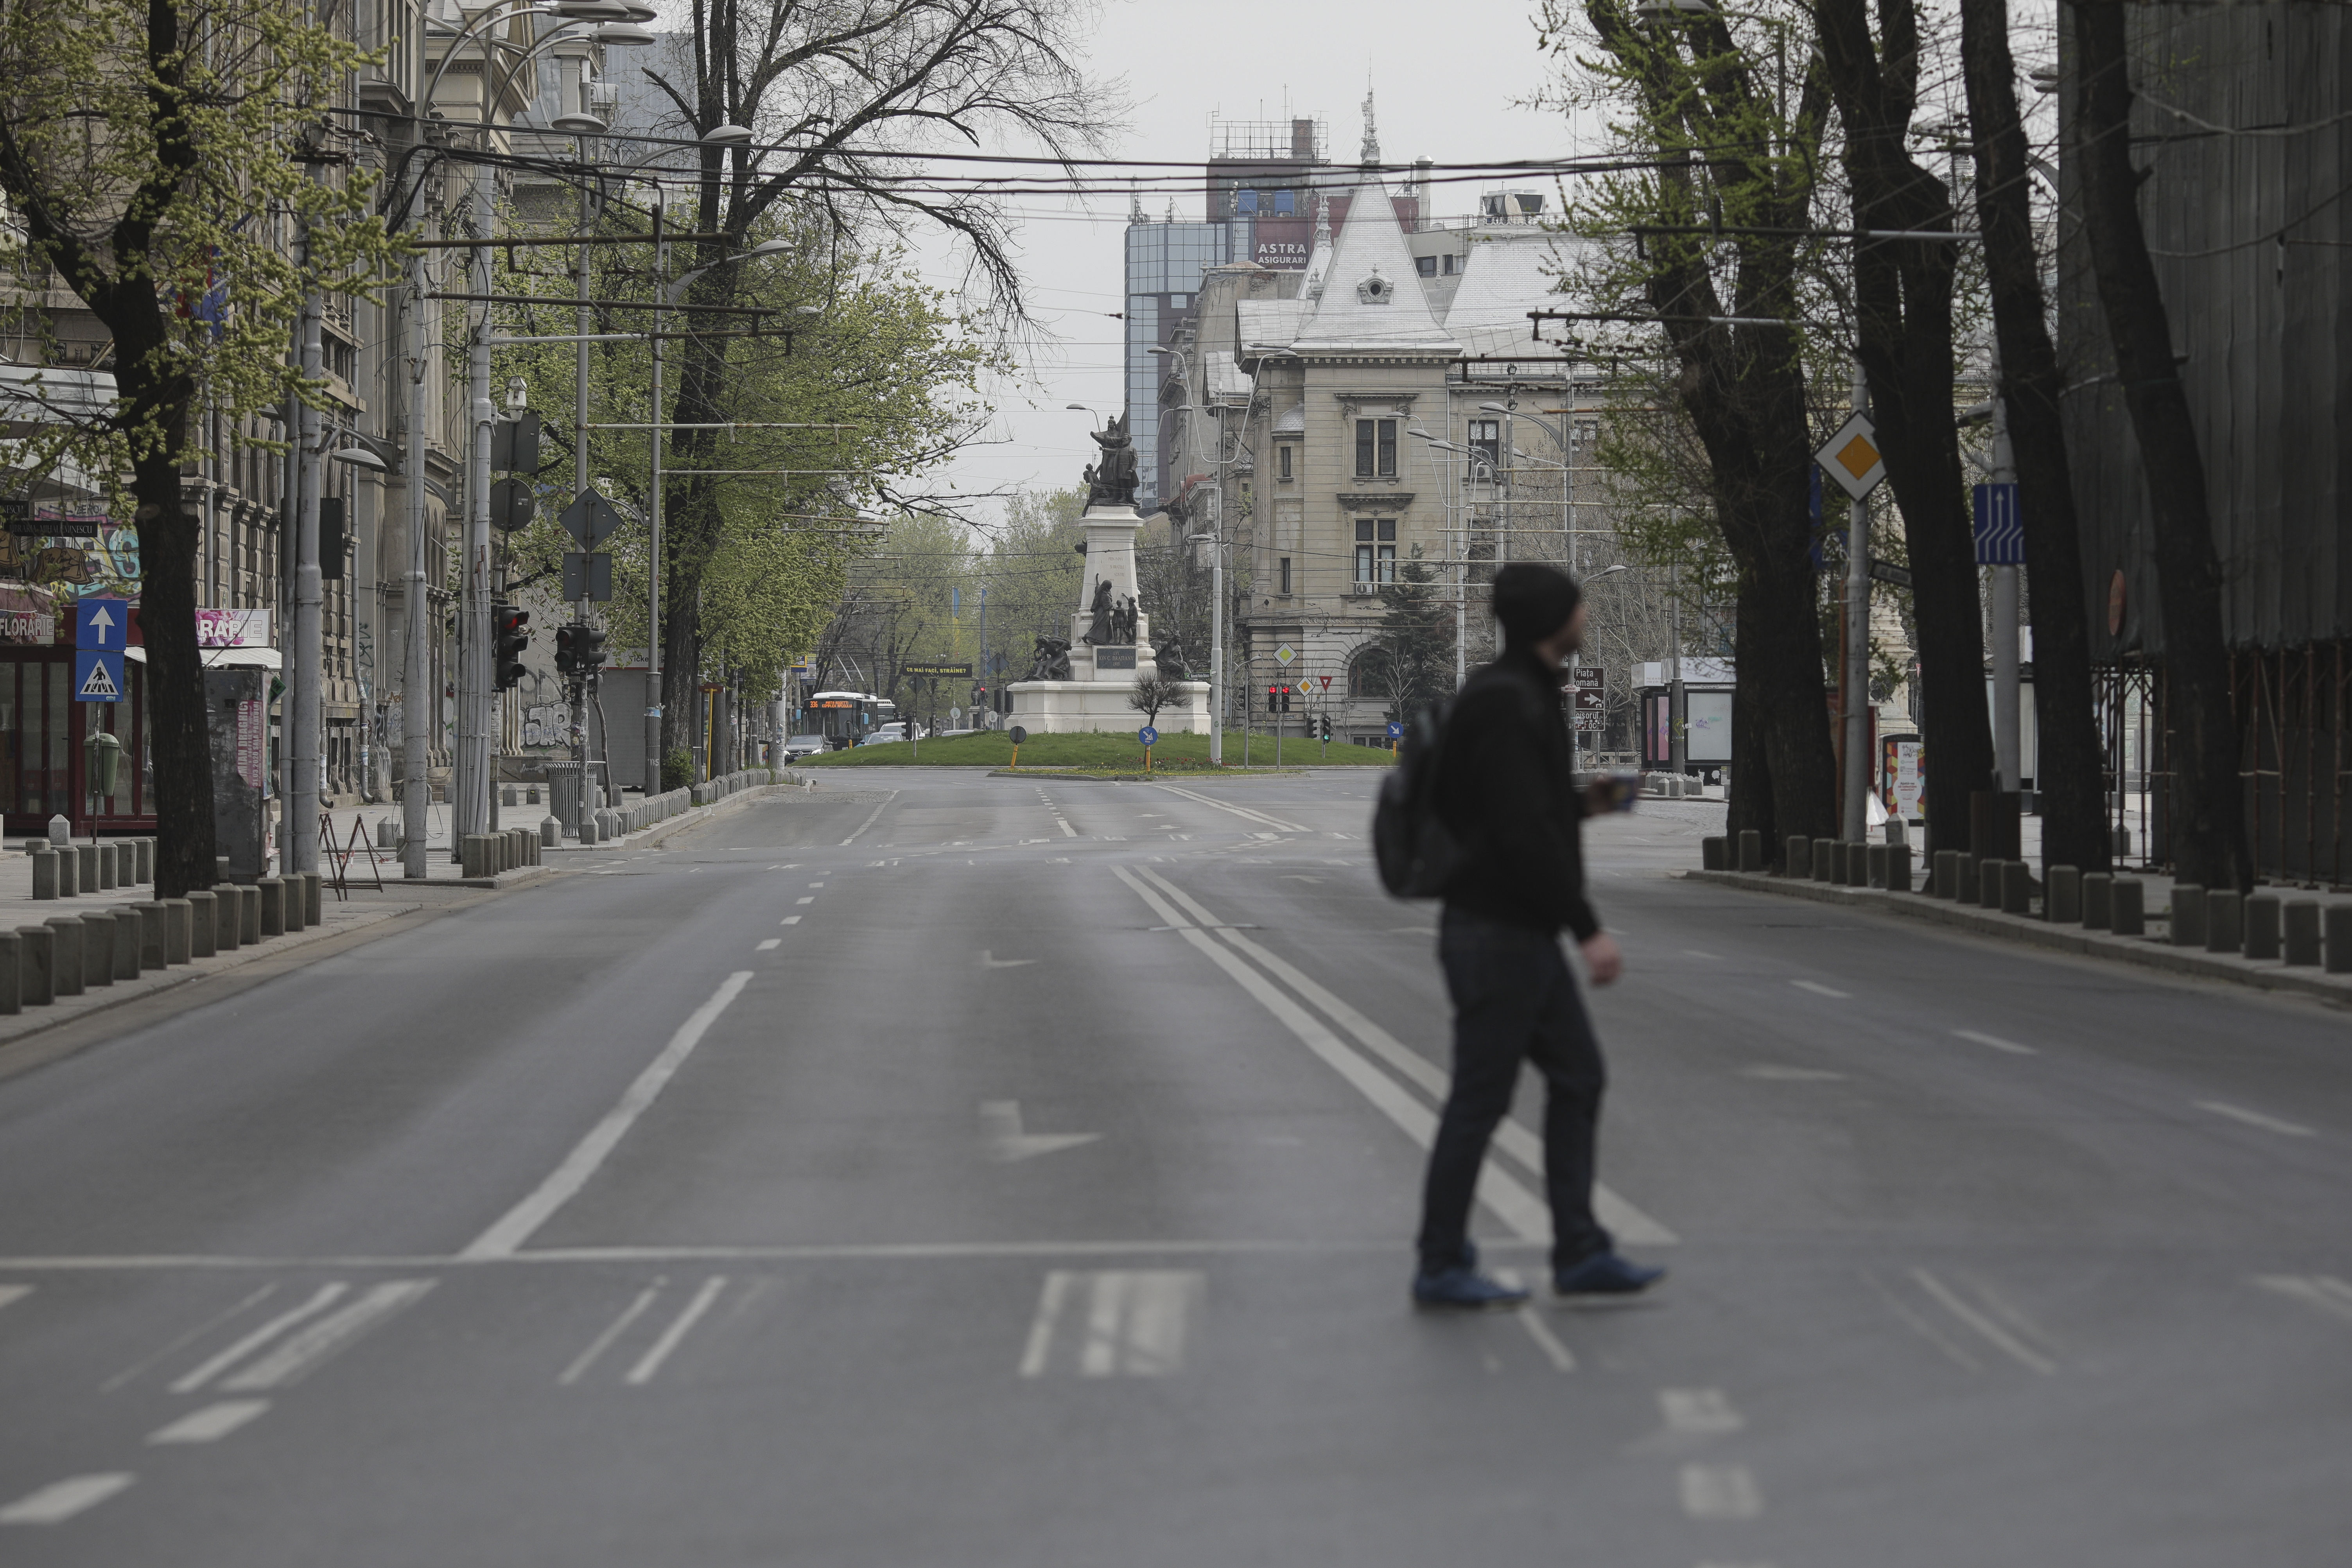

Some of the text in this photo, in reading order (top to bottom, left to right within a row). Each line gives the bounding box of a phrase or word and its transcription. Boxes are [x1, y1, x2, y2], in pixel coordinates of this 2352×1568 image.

[1258, 244, 1306, 254] ASTRA
[0, 618, 54, 637] FLORARIE
[196, 619, 263, 638] RARIE
